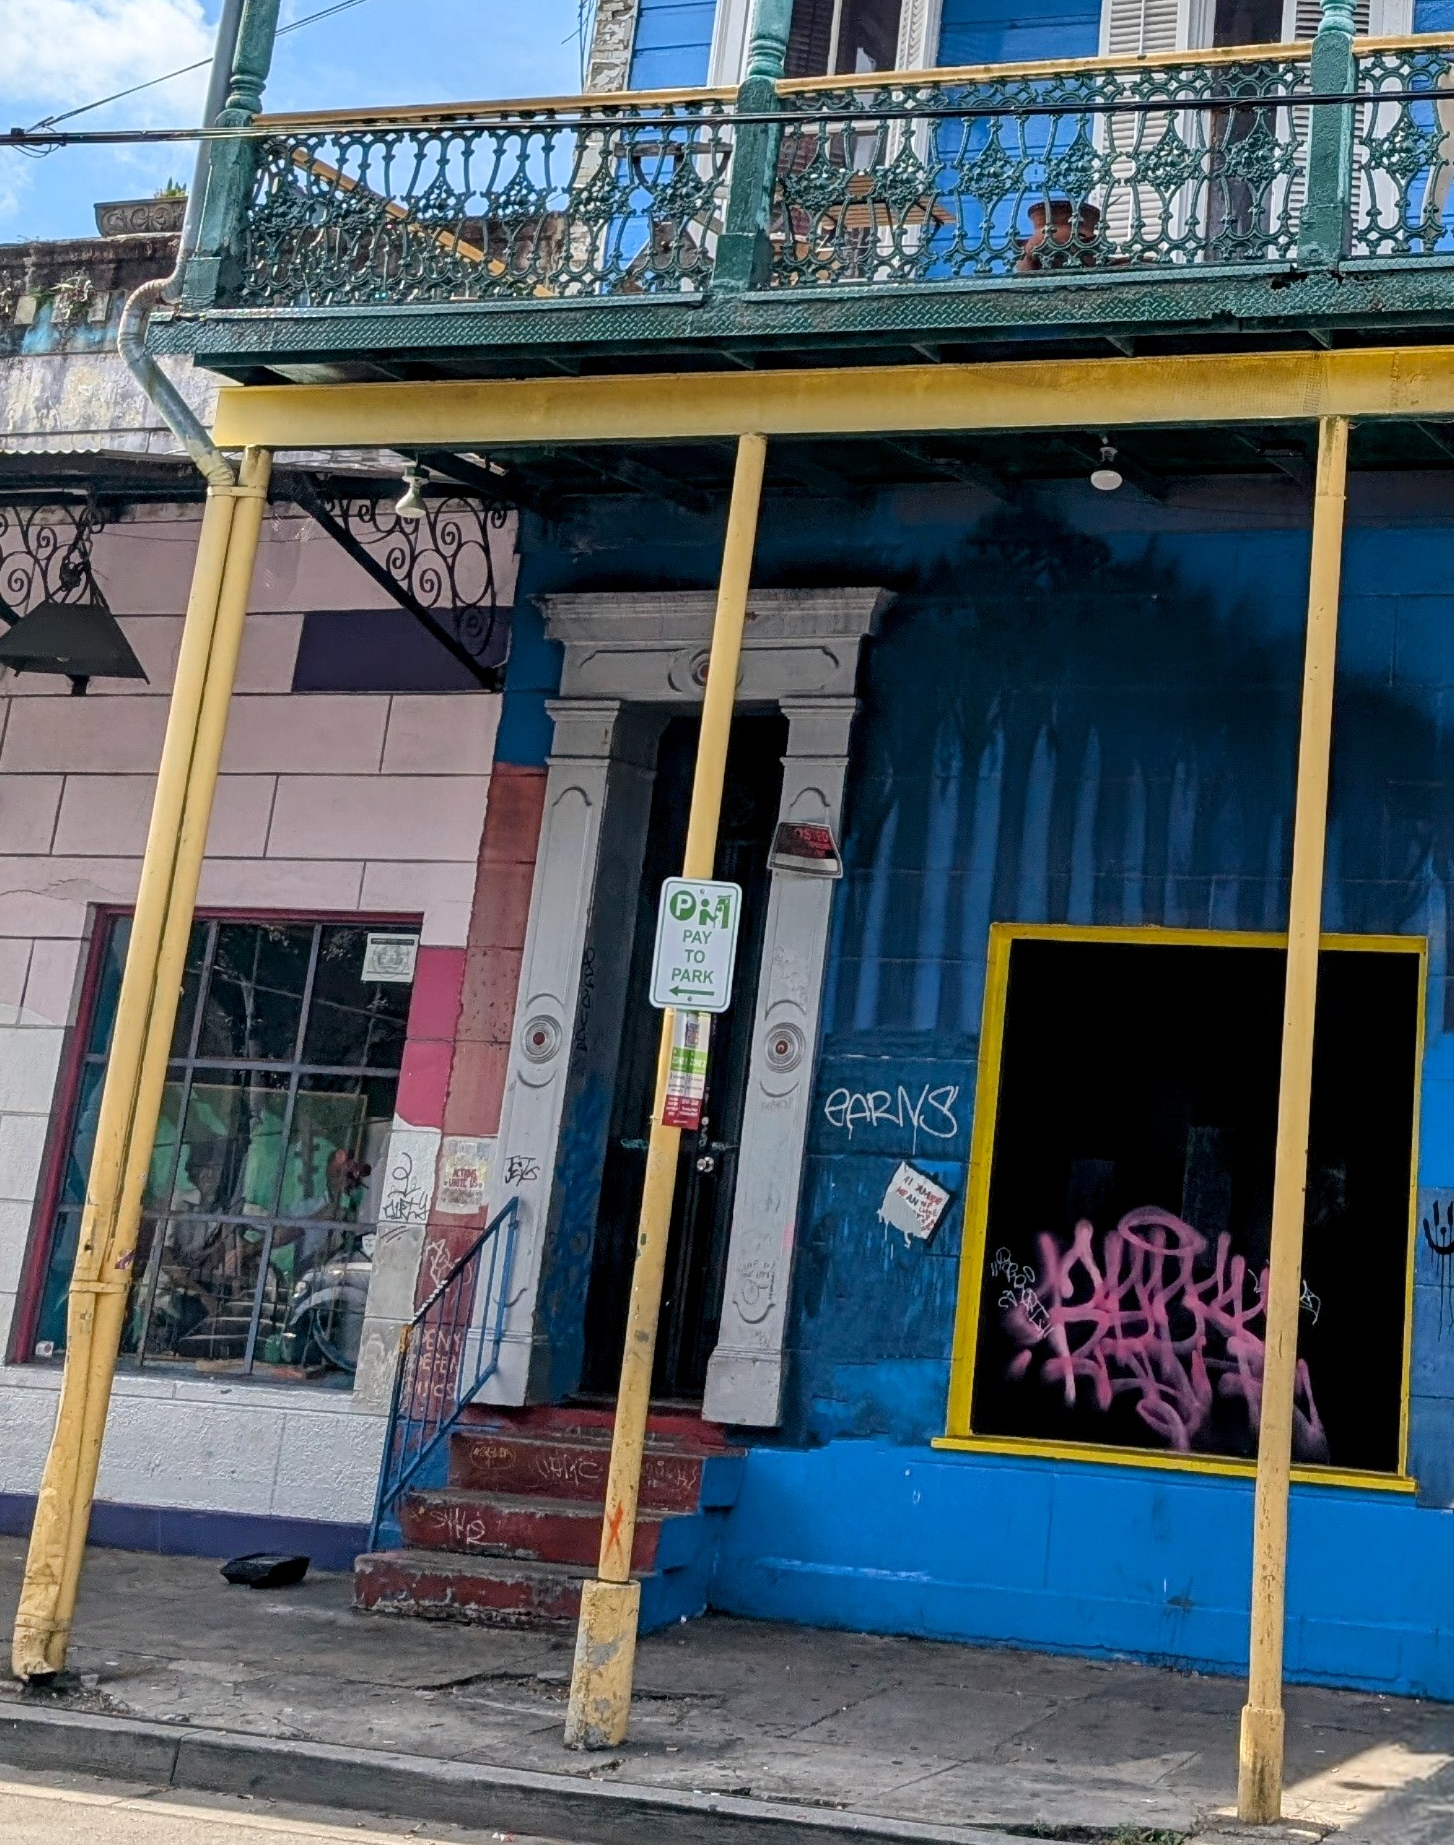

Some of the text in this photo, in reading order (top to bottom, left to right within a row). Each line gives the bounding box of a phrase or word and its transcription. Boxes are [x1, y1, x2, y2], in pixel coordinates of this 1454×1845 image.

[682, 929, 713, 945] PAY
[685, 948, 706, 964] TO
[671, 967, 714, 984] PARK
